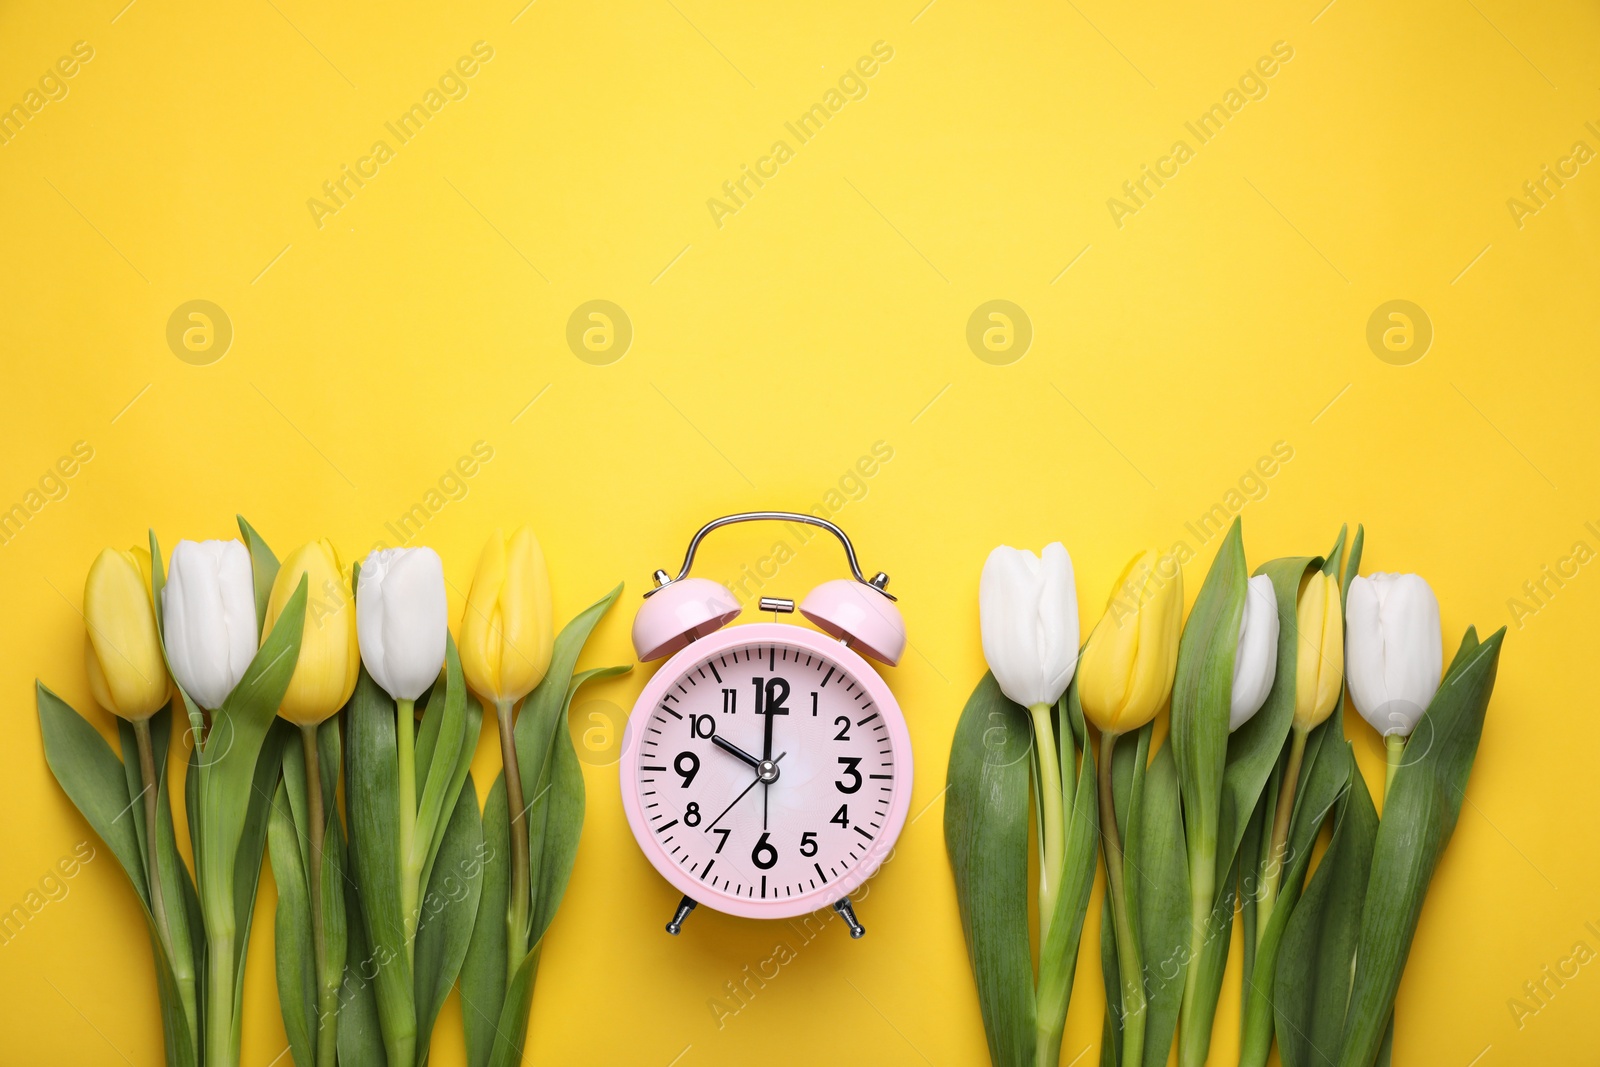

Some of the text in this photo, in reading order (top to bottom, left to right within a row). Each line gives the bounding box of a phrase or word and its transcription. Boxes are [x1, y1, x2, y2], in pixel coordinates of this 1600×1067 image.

[721, 688, 737, 714] 11
[752, 677, 791, 715] 12
[810, 691, 818, 717] 1
[688, 713, 716, 740] 10
[833, 715, 851, 741] 2
[673, 751, 700, 788] 9
[834, 757, 863, 794] 3
[683, 801, 701, 828] 8
[829, 804, 850, 829] 4
[713, 828, 732, 854] 7
[751, 832, 778, 870] 6
[799, 832, 818, 858] 5
